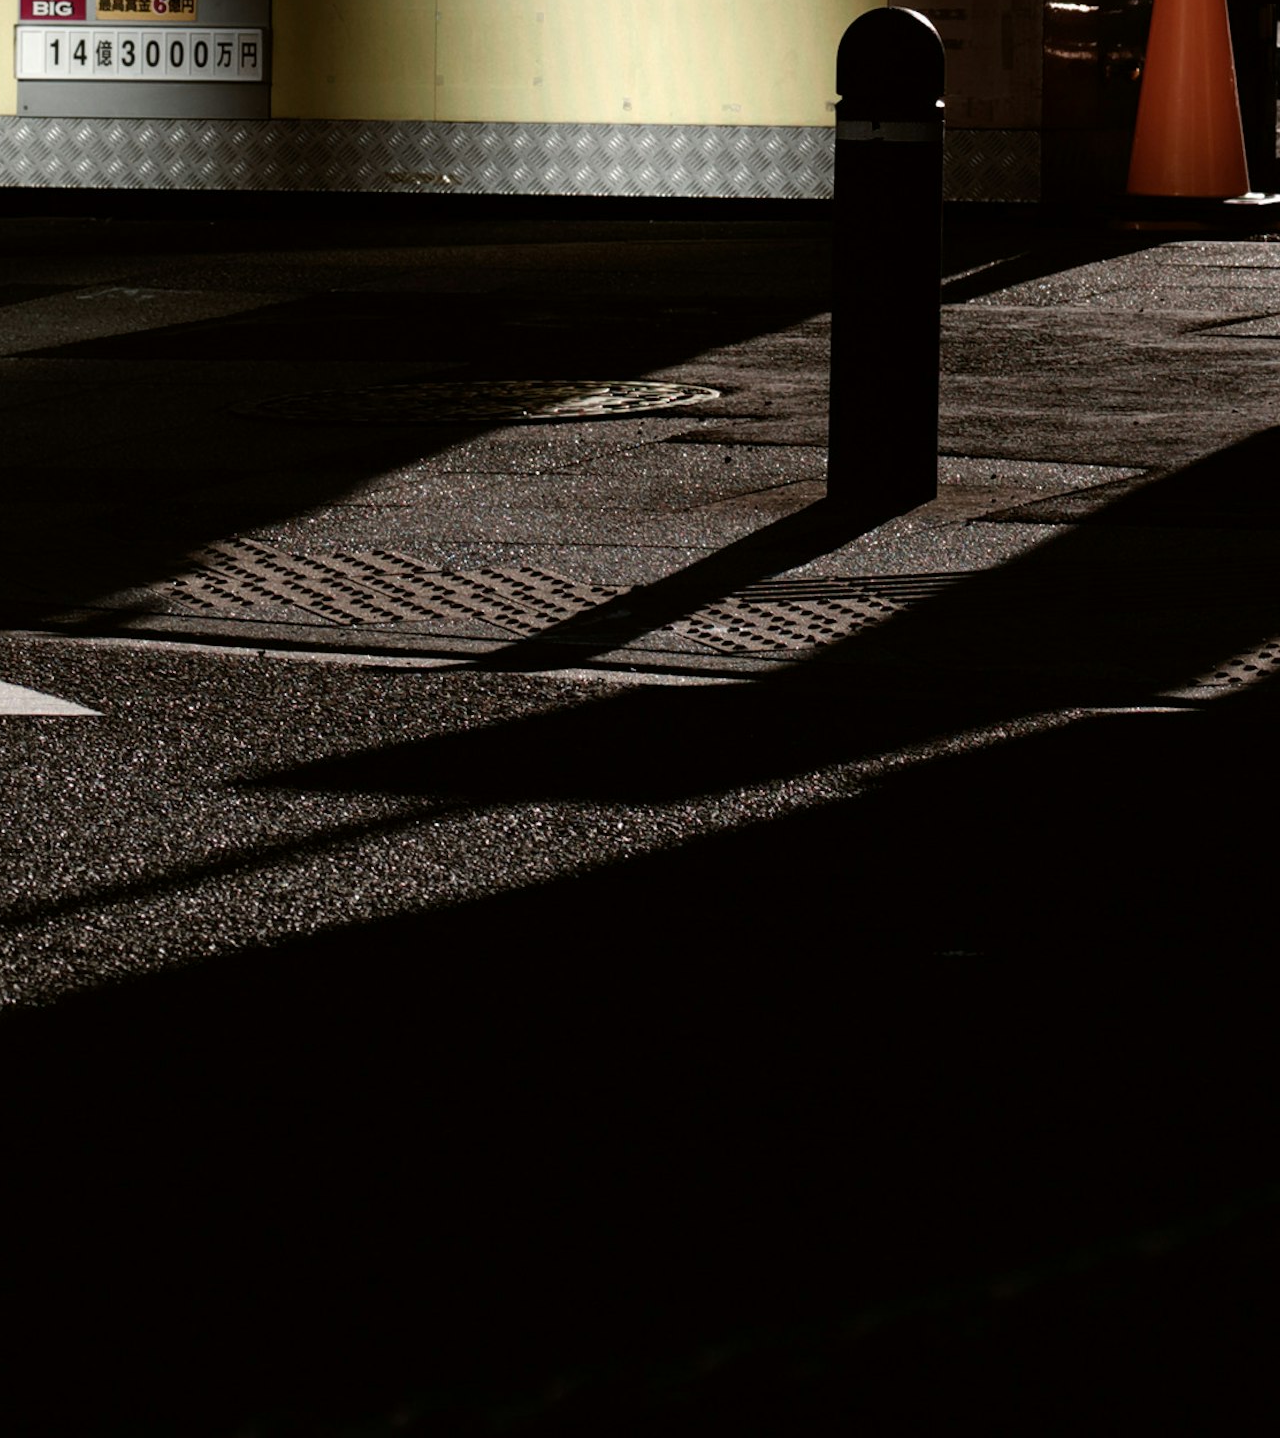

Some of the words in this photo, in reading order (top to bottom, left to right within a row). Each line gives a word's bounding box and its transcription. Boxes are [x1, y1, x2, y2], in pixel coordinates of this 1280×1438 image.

[31, 0, 74, 17] BIG
[49, 39, 258, 68] 14億3000万円
